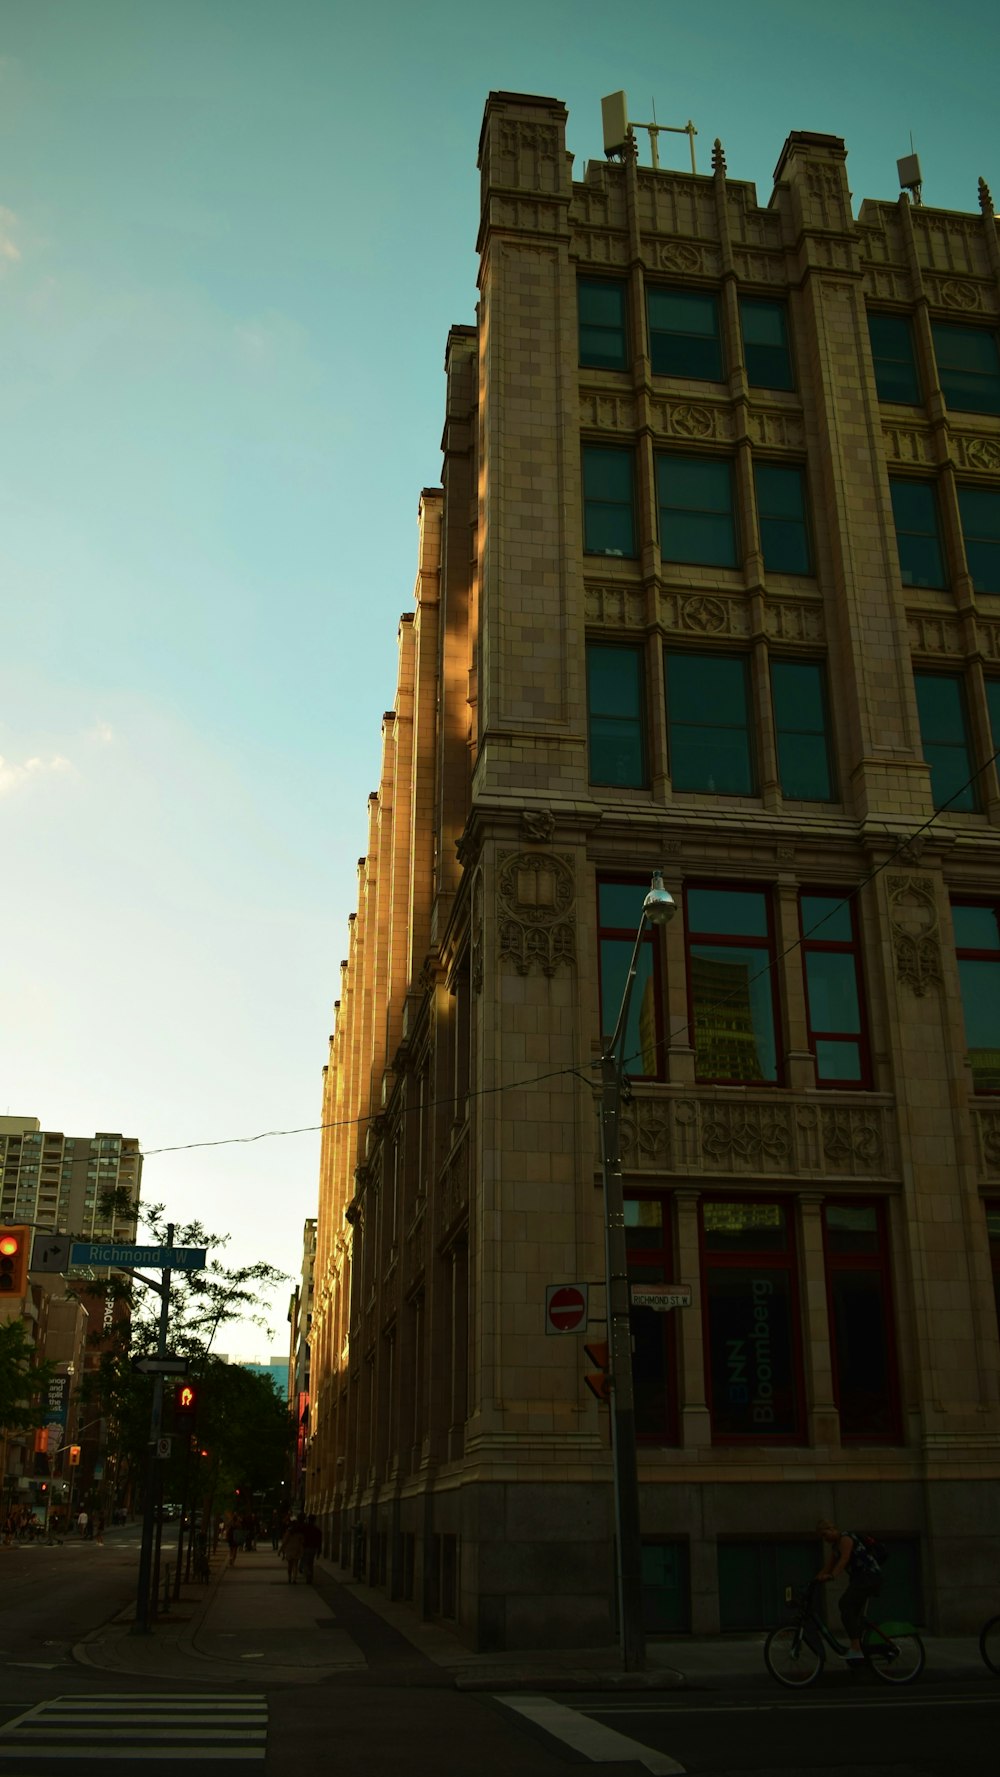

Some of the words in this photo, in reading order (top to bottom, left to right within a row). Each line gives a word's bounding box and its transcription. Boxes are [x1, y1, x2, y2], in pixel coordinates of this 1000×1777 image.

[89, 1246, 161, 1263] Richmond
[175, 1249, 188, 1264] W
[633, 1296, 669, 1305] RICHMOND
[670, 1296, 679, 1305] ST
[681, 1296, 688, 1305] W
[748, 1279, 775, 1423] Bloomberg
[725, 1339, 748, 1405] BNN
[48, 1391, 63, 1399] split
